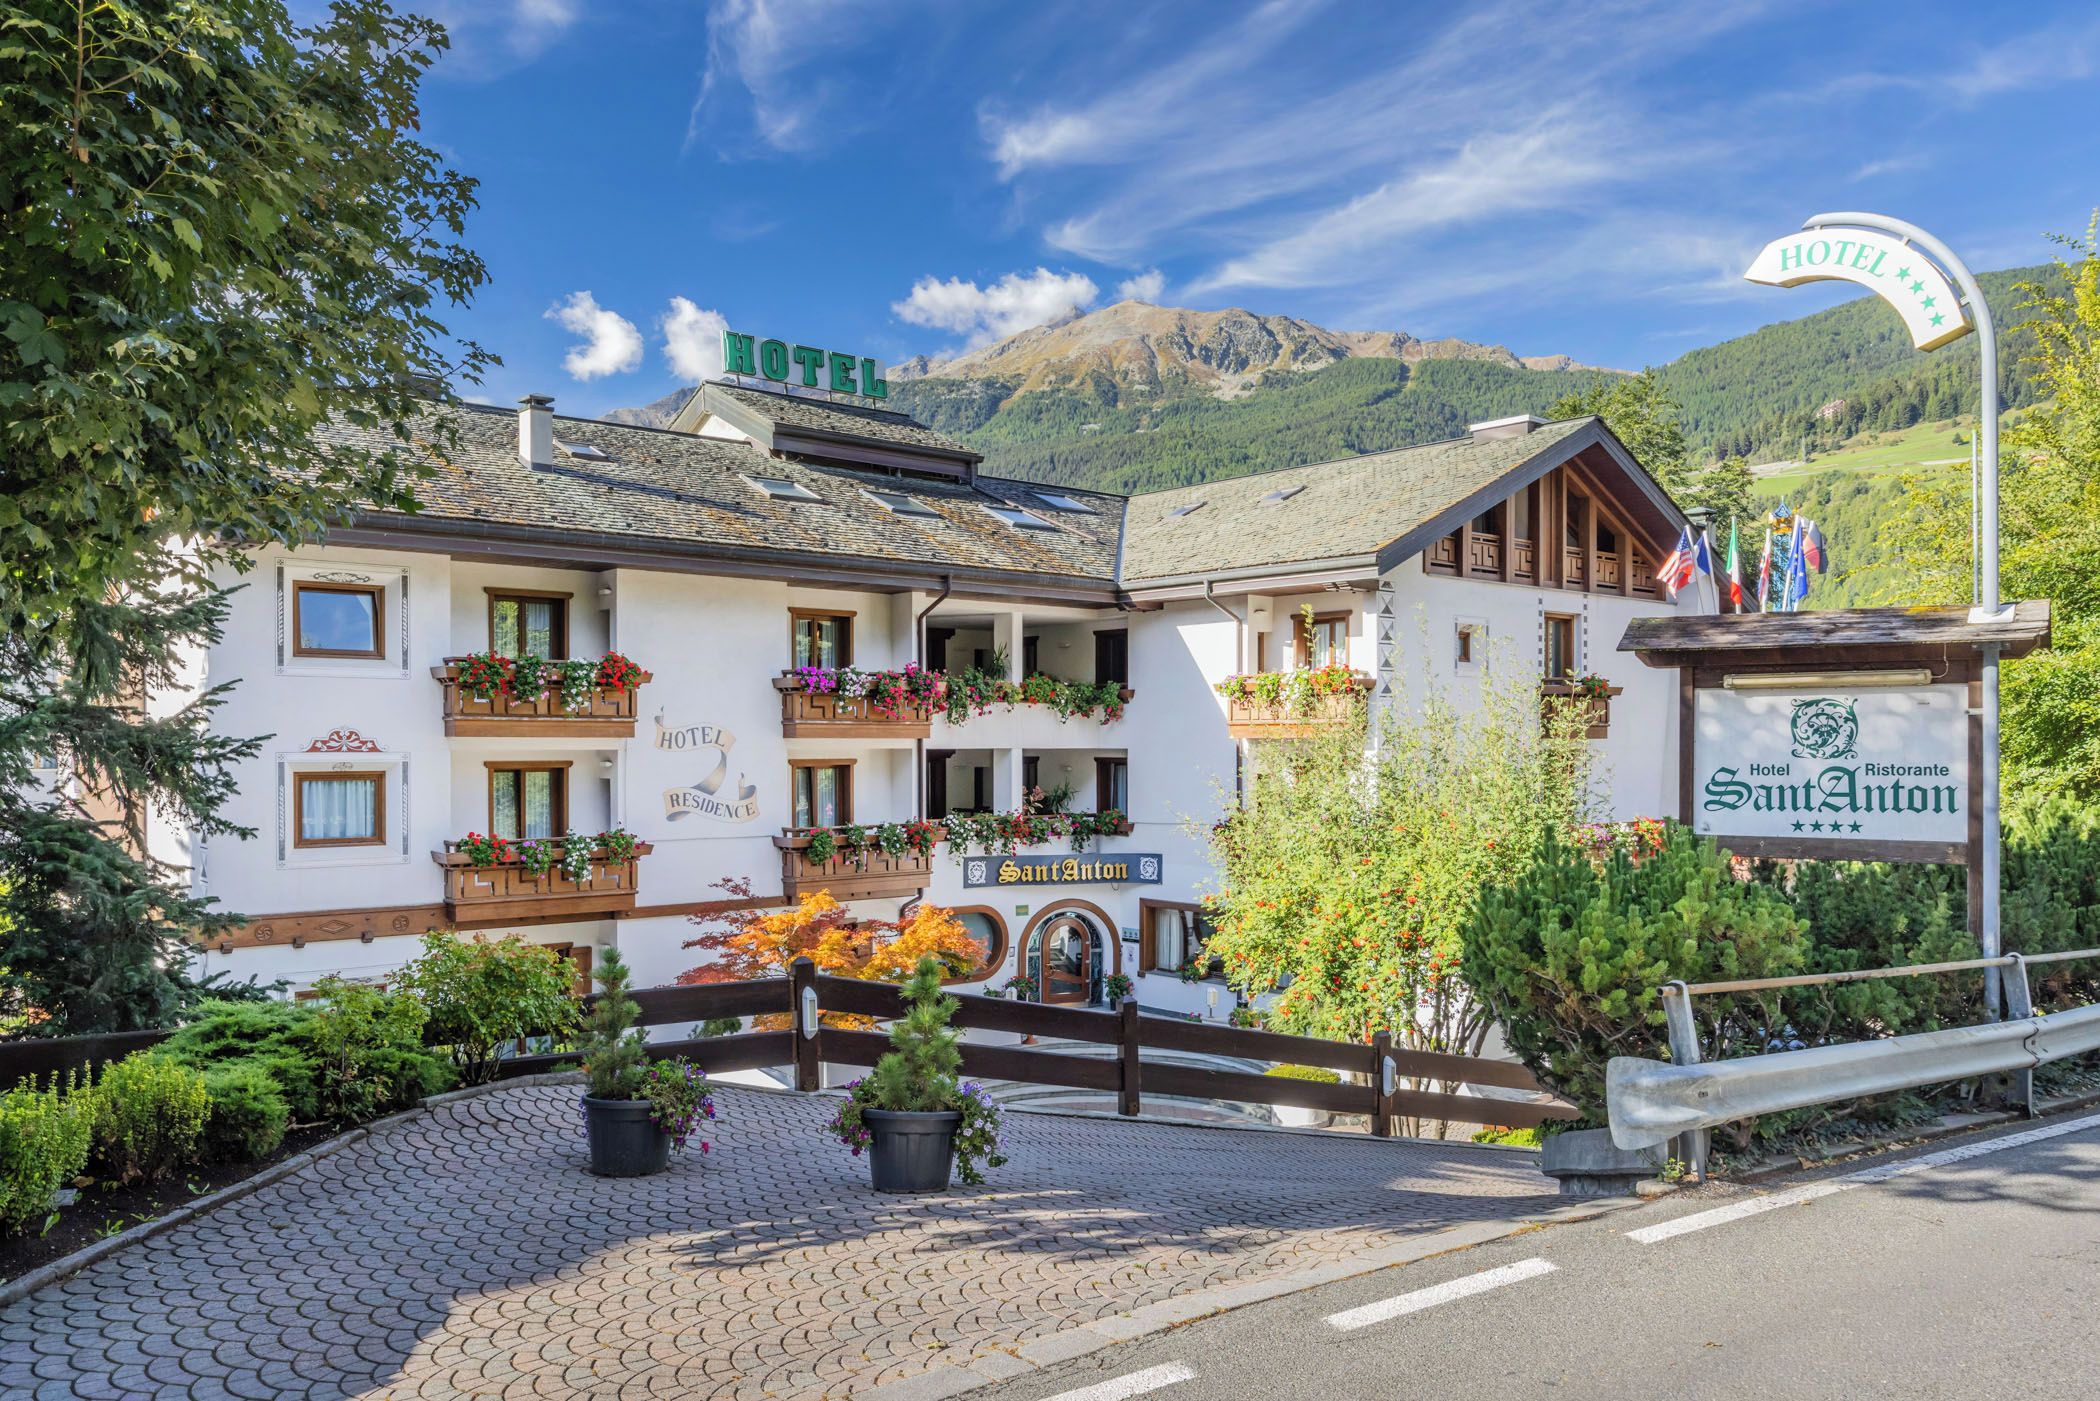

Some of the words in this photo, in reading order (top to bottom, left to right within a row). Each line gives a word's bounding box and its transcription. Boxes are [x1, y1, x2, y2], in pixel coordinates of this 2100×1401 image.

[1780, 240, 1888, 278] HOTEL
[722, 330, 887, 399] HOTEL
[660, 726, 725, 750] HOTEL
[1750, 762, 1790, 777] Hotel
[1865, 762, 1950, 777] Ristorante
[669, 792, 756, 819] RESIDENCE
